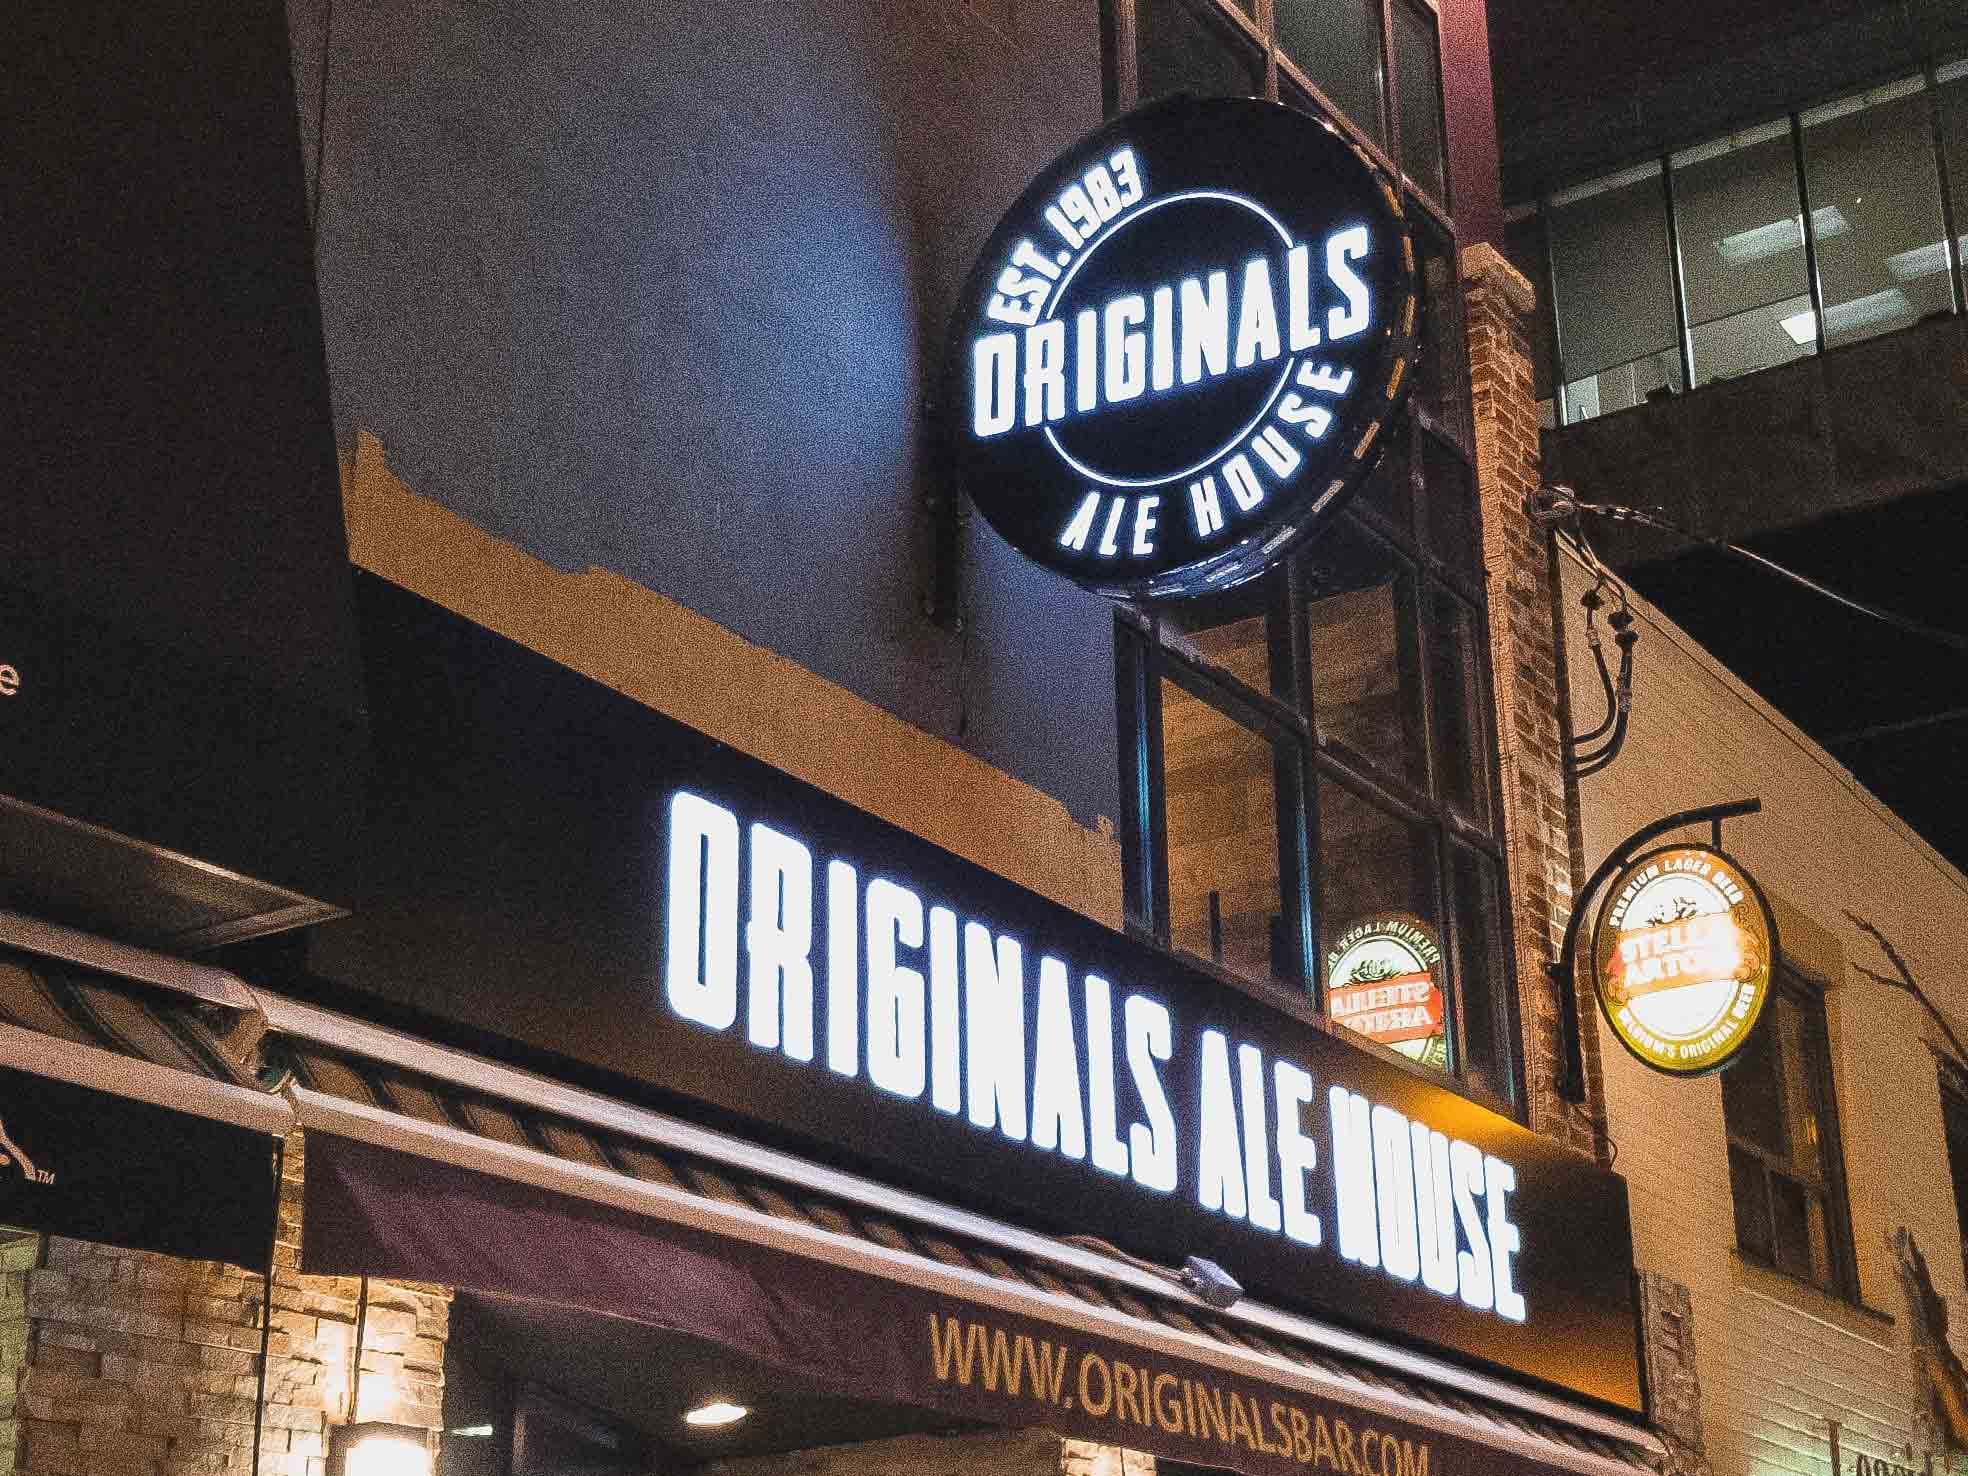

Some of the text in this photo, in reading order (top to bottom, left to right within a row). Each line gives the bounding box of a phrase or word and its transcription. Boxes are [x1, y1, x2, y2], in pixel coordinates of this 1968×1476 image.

[973, 224, 1371, 438] ORIGINALS
[1059, 360, 1354, 557] ALE HOUSE
[666, 790, 1527, 1323] ORIGINALS ALE HOUSE
